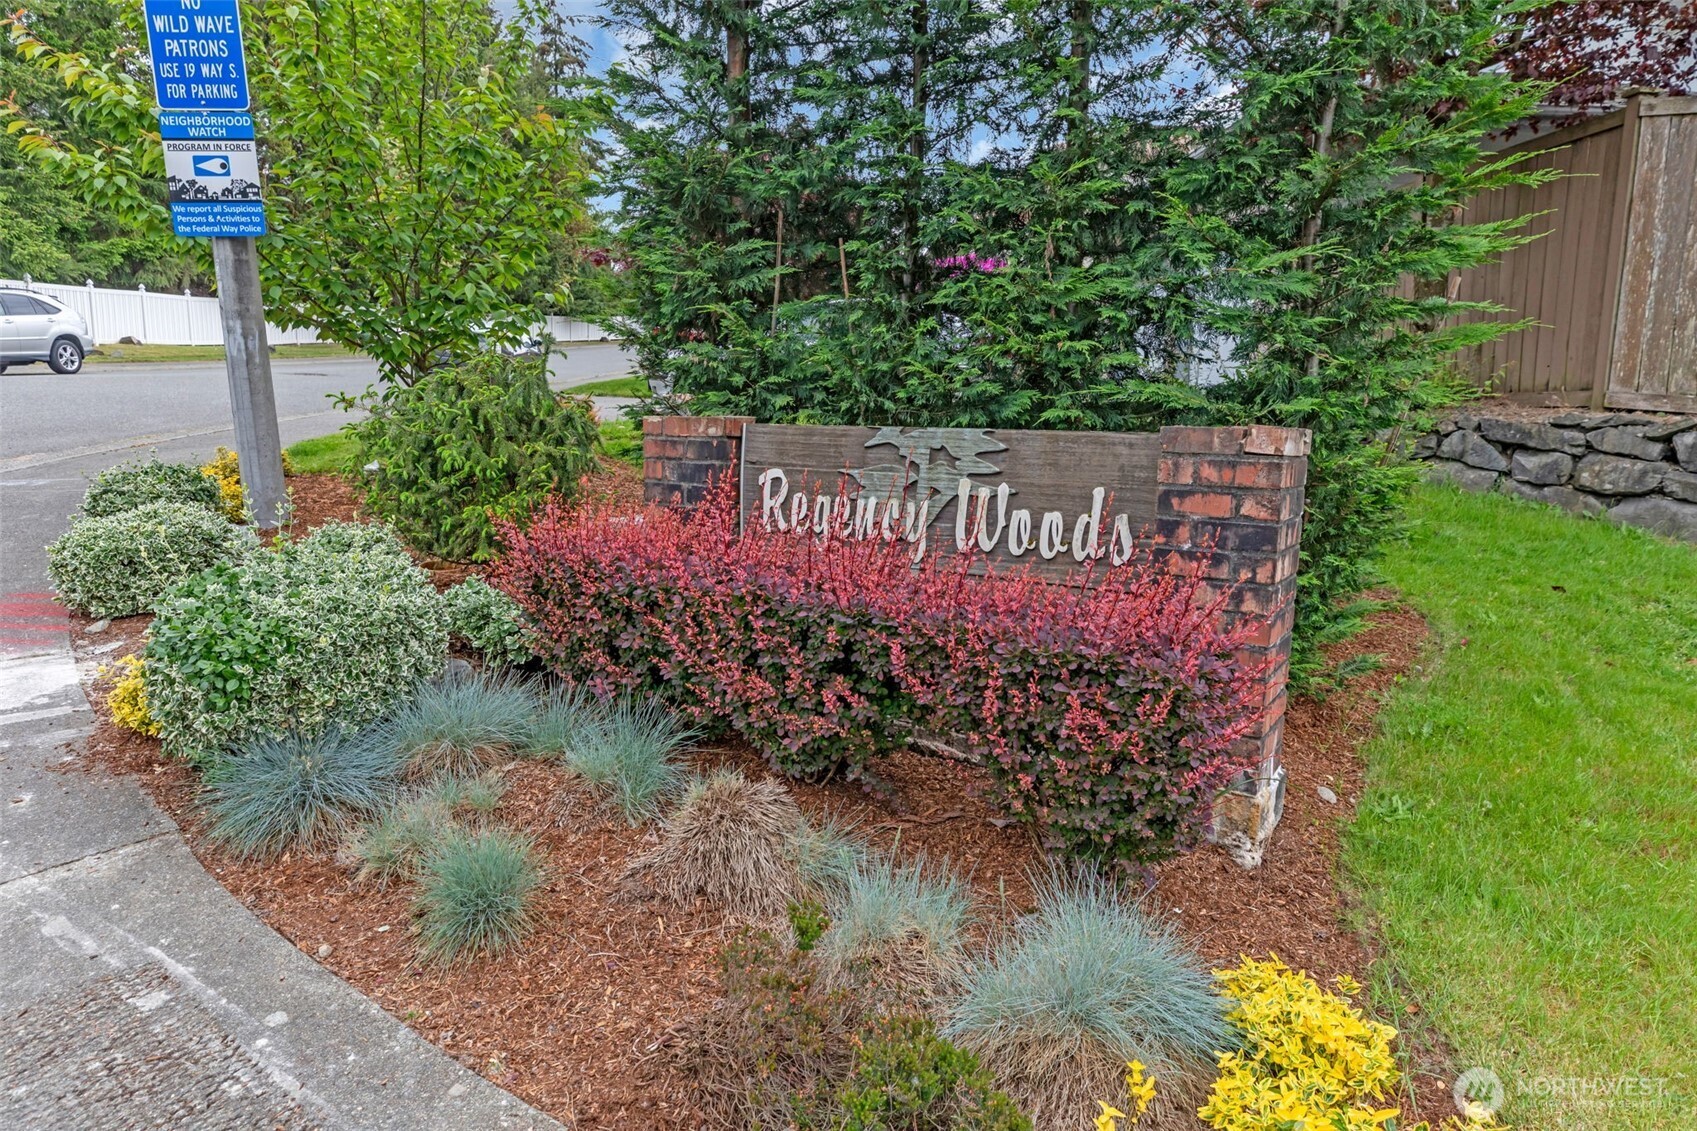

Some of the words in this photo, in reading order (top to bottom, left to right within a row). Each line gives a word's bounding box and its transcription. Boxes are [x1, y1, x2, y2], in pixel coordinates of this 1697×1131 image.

[153, 15, 188, 32] WILD
[194, 16, 234, 33] WAVE
[164, 40, 228, 57] PATRONS
[160, 63, 180, 78] USE
[184, 63, 195, 78] 19
[200, 63, 223, 78] WAY
[229, 63, 239, 78] S.
[166, 84, 187, 98] FOR
[191, 84, 238, 99] PARKING
[161, 116, 251, 126] NEIGHBORHOOD
[188, 127, 226, 137] WATCH
[167, 143, 211, 151] PROGRAM
[213, 143, 222, 151] IN
[225, 143, 251, 151] FORCE
[172, 205, 185, 213] We
[187, 205, 211, 214] report
[213, 205, 222, 213] all
[223, 205, 262, 214] Suspicious
[177, 215, 207, 223] Persons
[208, 215, 215, 223] &
[216, 215, 250, 223] Activities
[252, 215, 260, 223] to
[178, 225, 191, 233] the
[192, 225, 219, 233] Federal
[221, 225, 238, 234] Way
[240, 225, 261, 233] Police
[758, 468, 929, 564] Regency
[955, 478, 1133, 567] Woods
